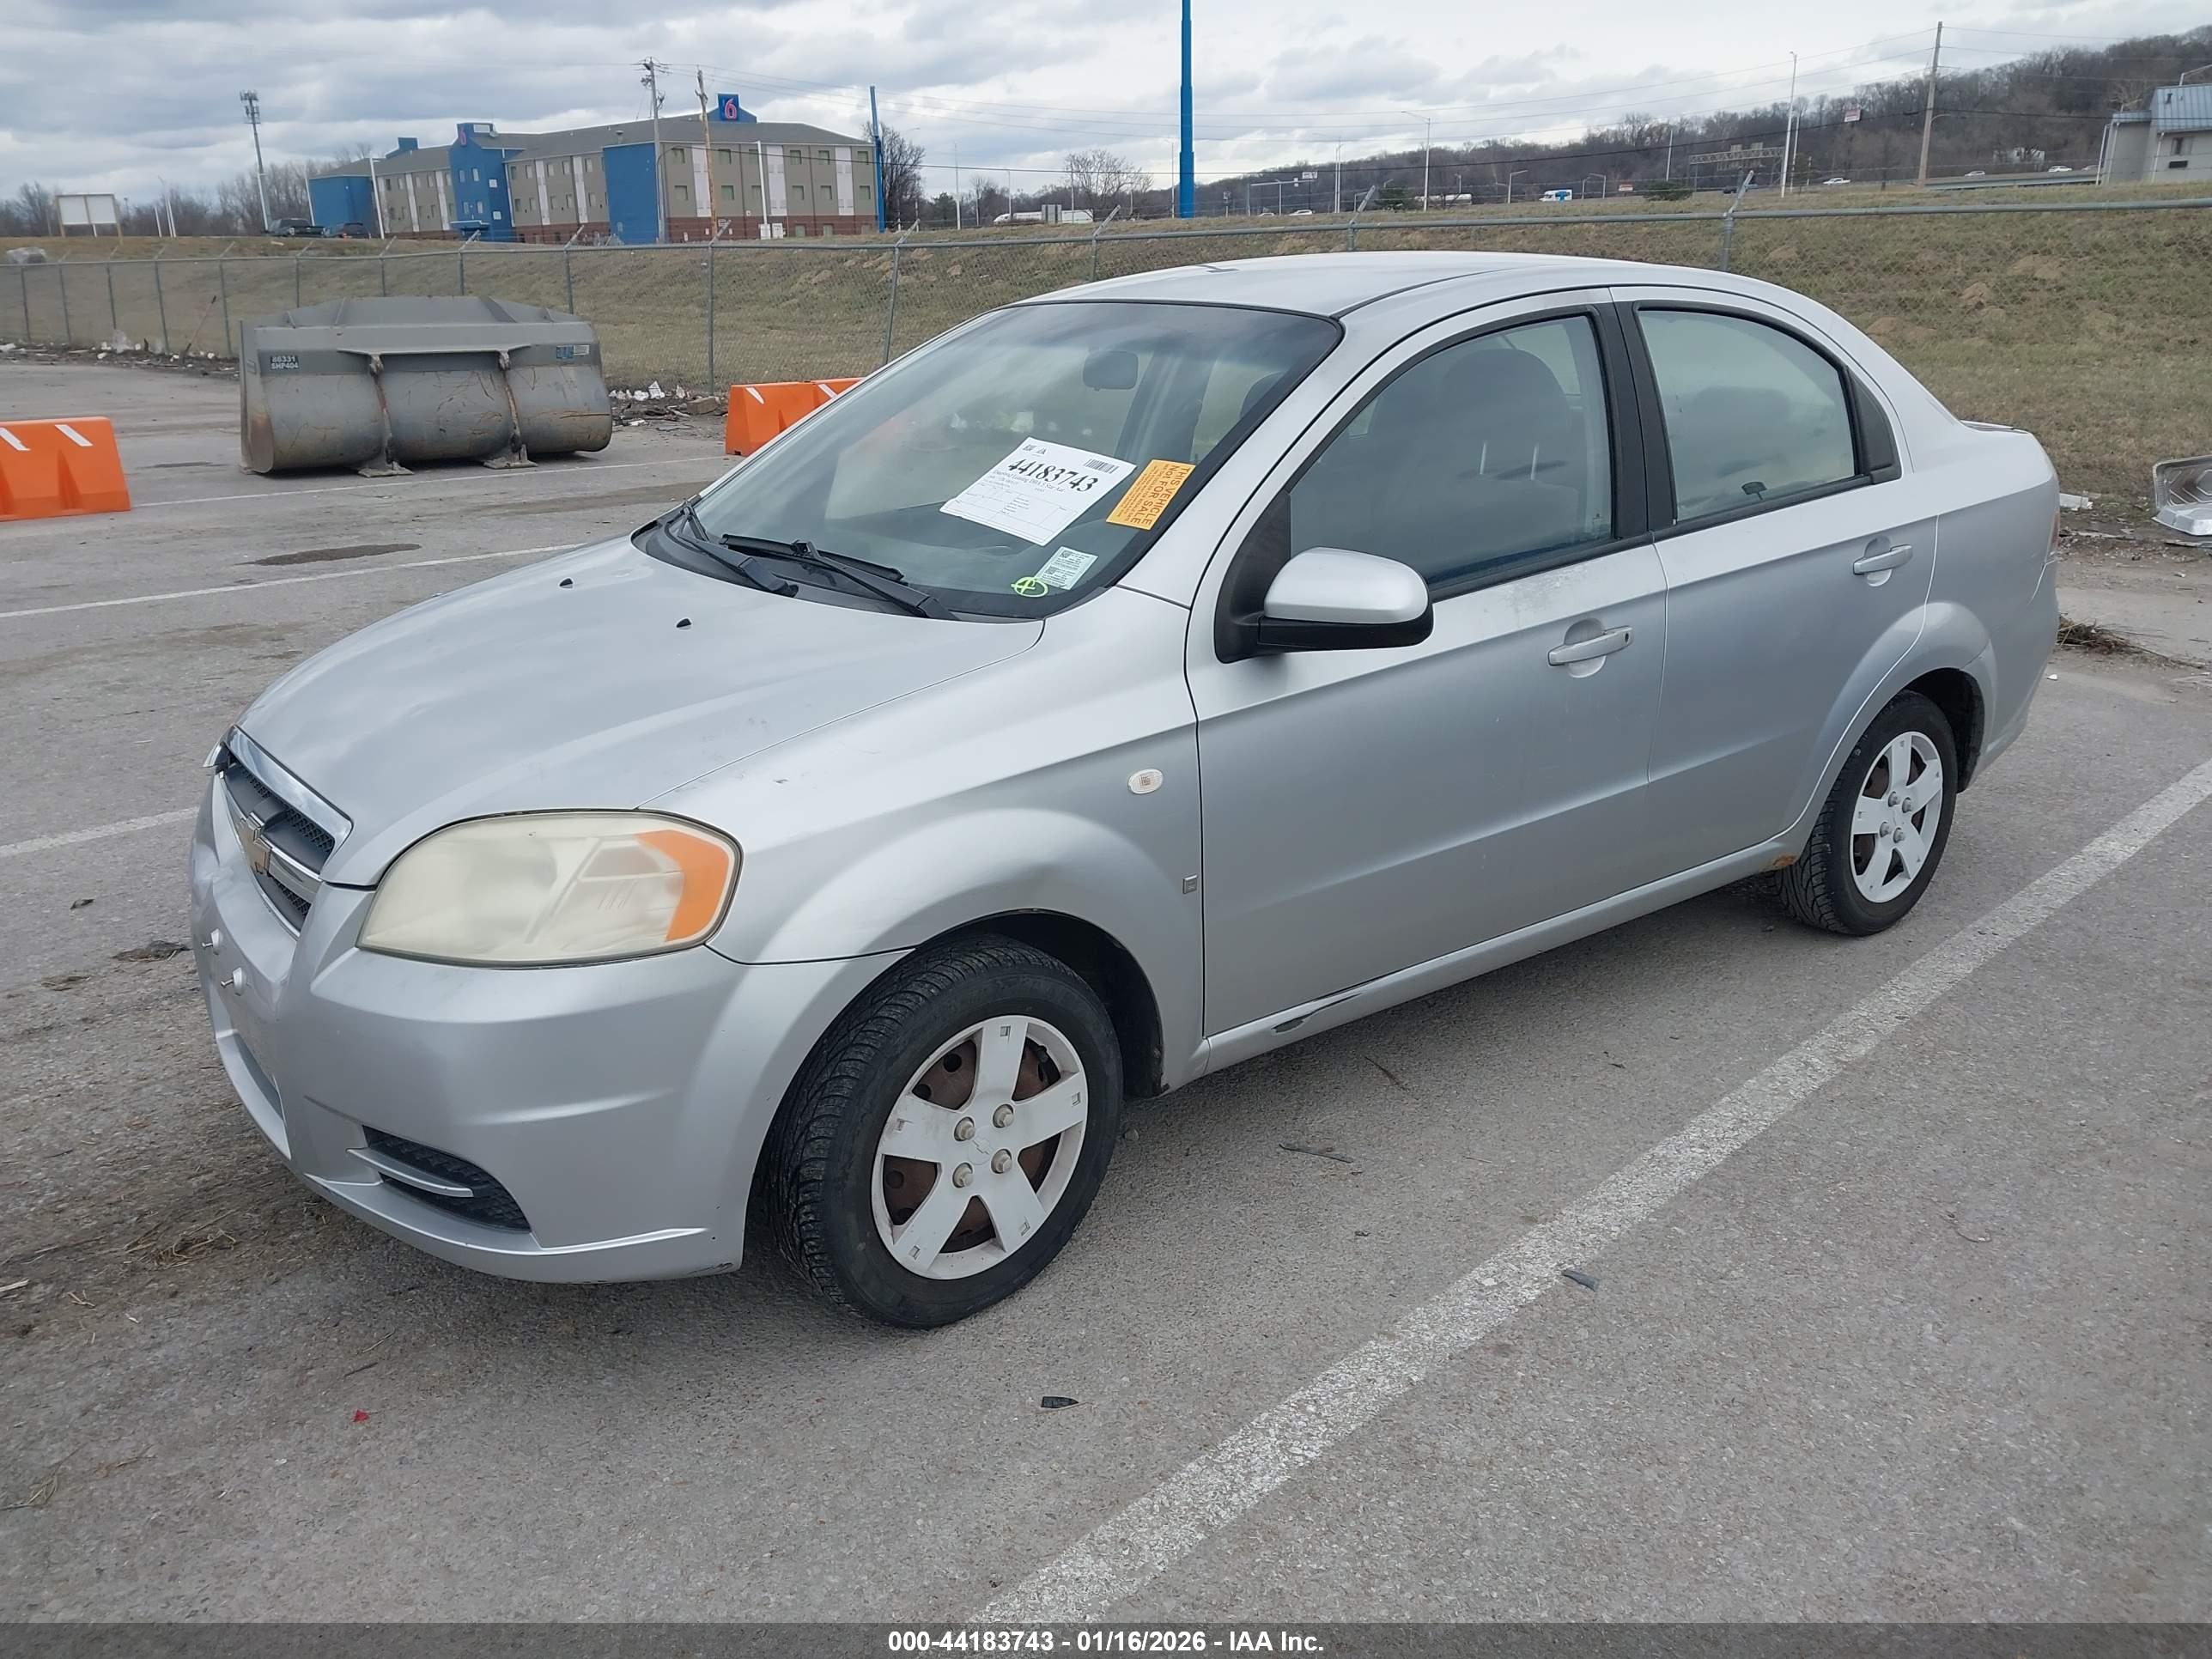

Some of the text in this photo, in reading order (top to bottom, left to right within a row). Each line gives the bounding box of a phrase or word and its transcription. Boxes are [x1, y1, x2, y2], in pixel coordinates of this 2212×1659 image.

[725, 97, 738, 119] 6
[1007, 458, 1099, 493] 44183743
[1170, 466, 1190, 486] THIS
[1148, 480, 1168, 499] FOR
[1130, 500, 1153, 524] SALE
[1141, 488, 1174, 526] VEHICLE
